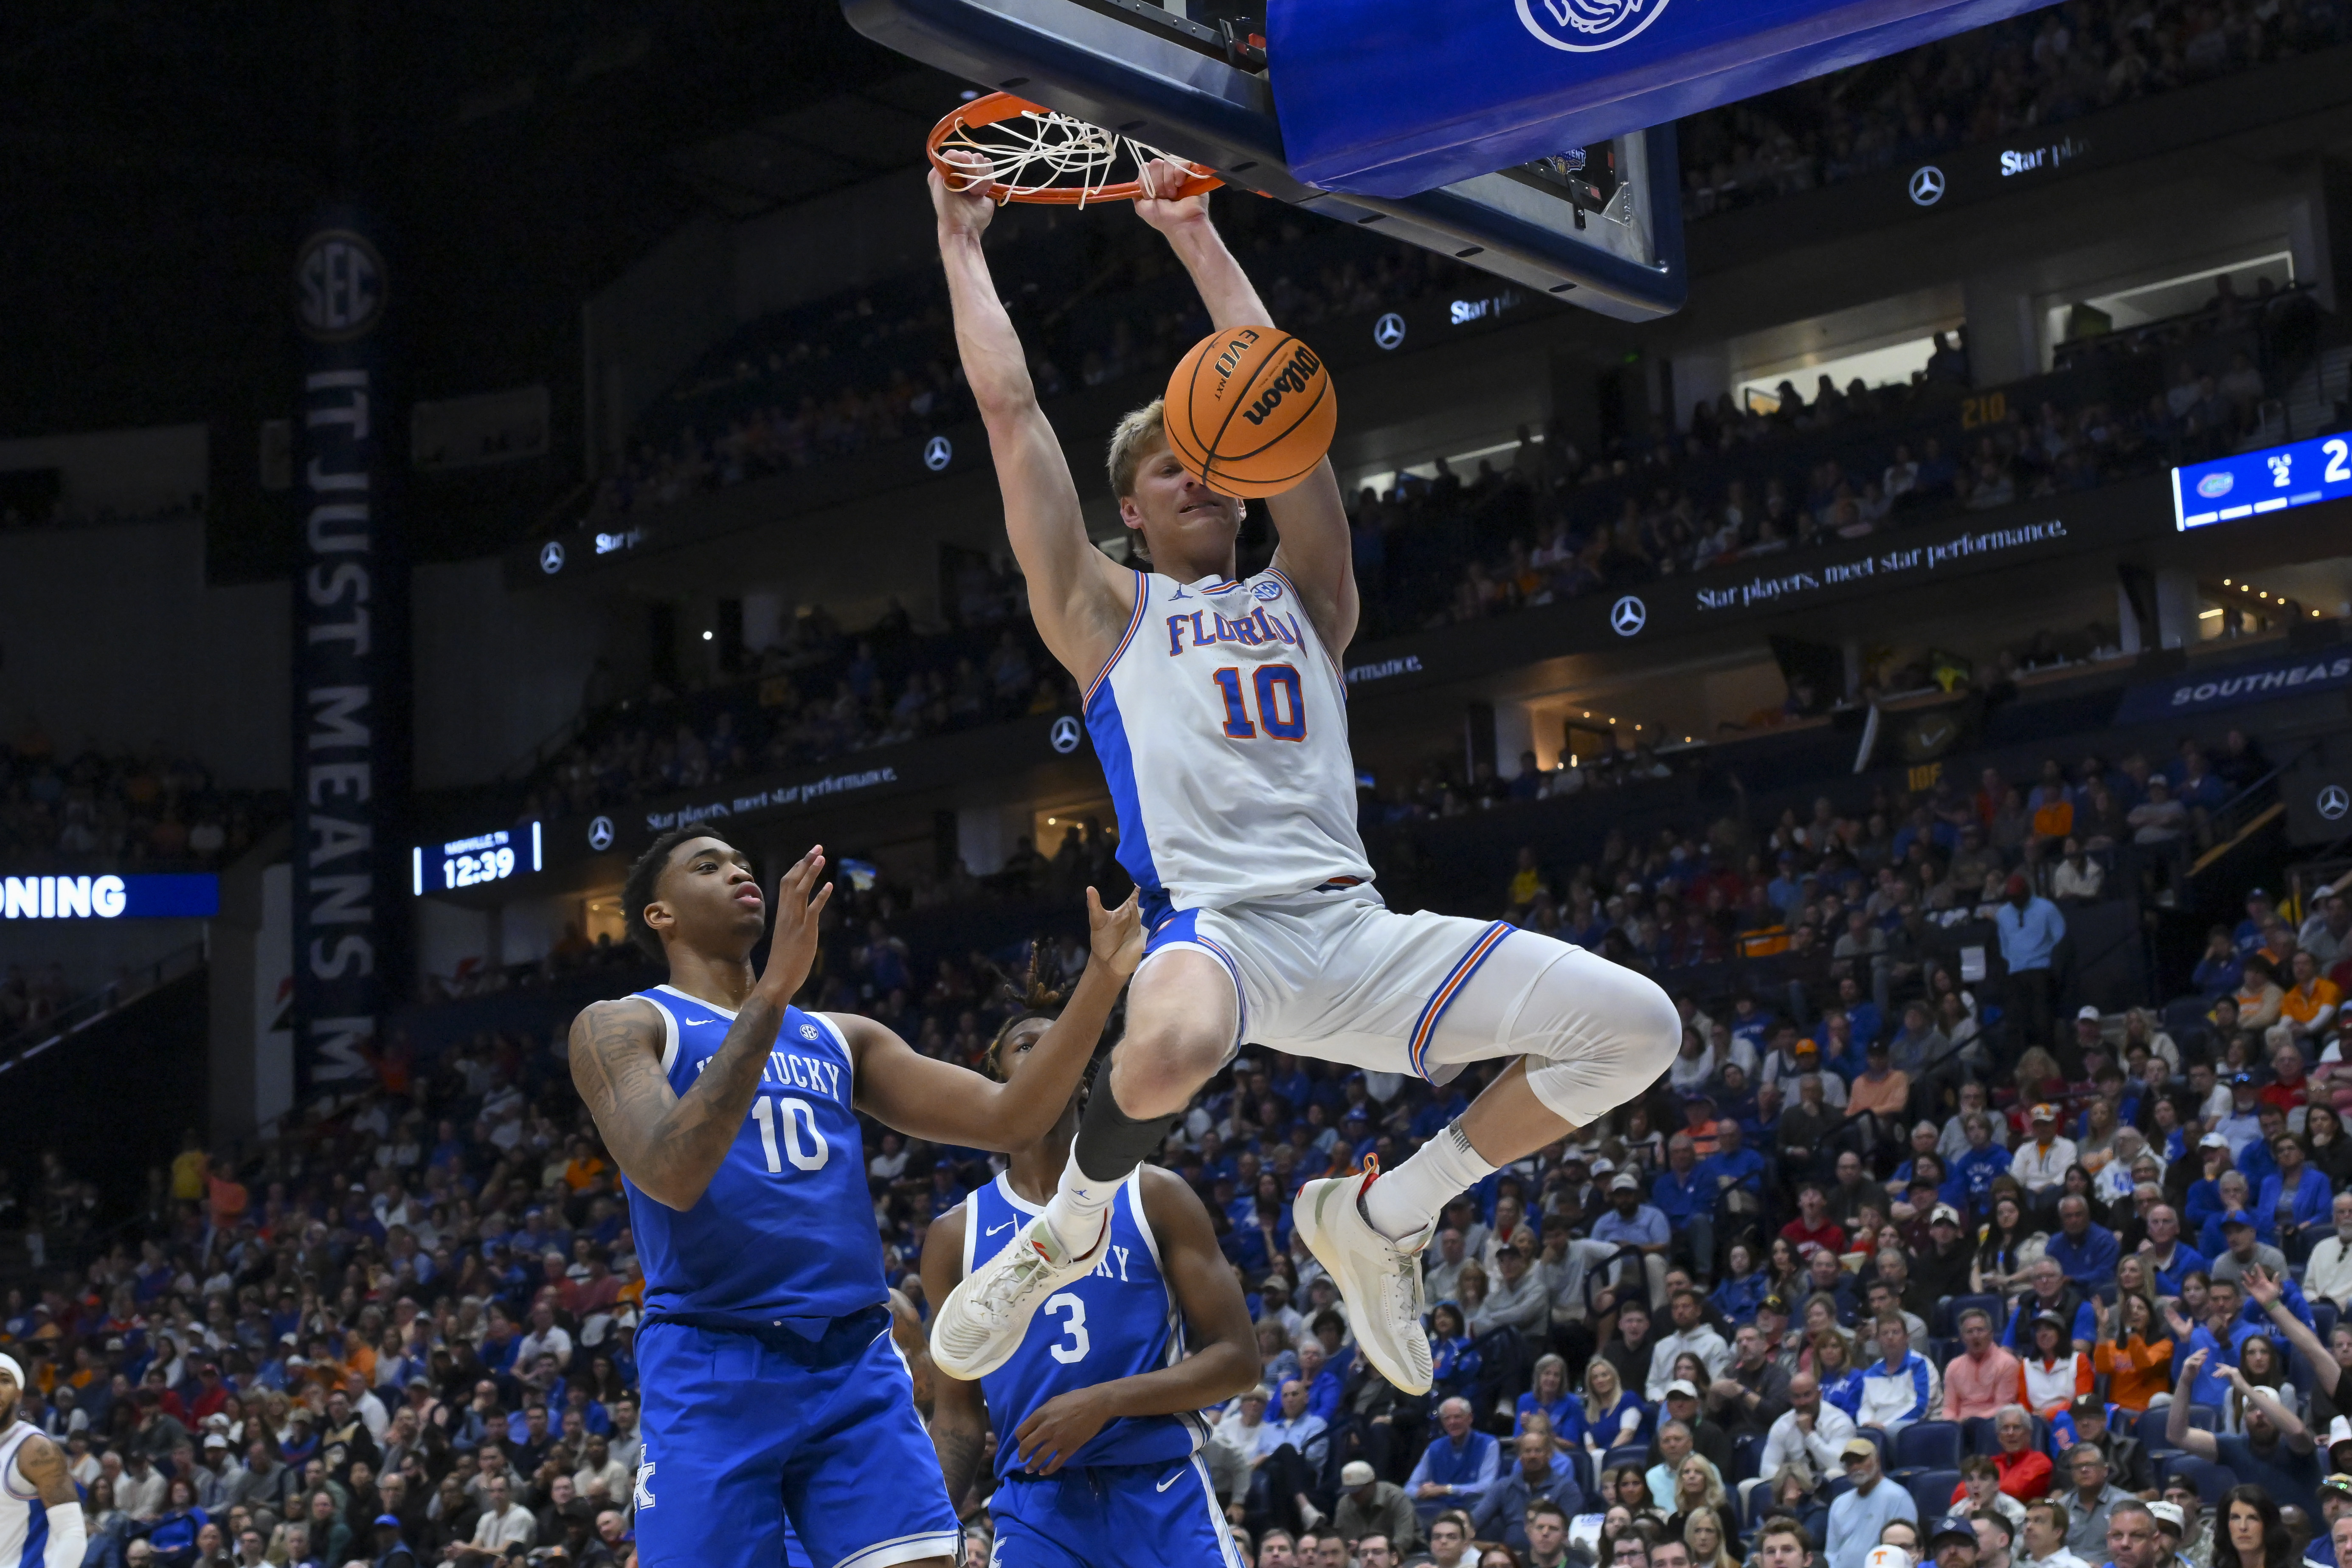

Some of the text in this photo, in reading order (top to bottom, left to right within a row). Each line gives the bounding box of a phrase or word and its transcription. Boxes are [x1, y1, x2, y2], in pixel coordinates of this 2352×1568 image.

[2000, 148, 2046, 177] Star
[1214, 329, 1260, 402] EVO NXT
[1242, 345, 1320, 425] Wilson
[2272, 465, 2290, 488] 2
[2321, 439, 2352, 483] 2
[306, 456, 372, 656] JUST
[1697, 519, 2067, 611] Star players, meet star performance.
[1213, 664, 1308, 743] 10
[2170, 657, 2352, 706] SOUTHEAS
[646, 811, 675, 832] Star
[732, 791, 768, 813] meet
[770, 785, 799, 804] star
[801, 766, 898, 804] performance.
[307, 684, 375, 981] MEANS
[0, 875, 127, 919] NING
[443, 847, 515, 889] 12:39
[801, 1025, 818, 1039] SEC
[751, 1096, 828, 1173] 10
[1044, 1292, 1090, 1365] 3
[1873, 1551, 1888, 1565] T
